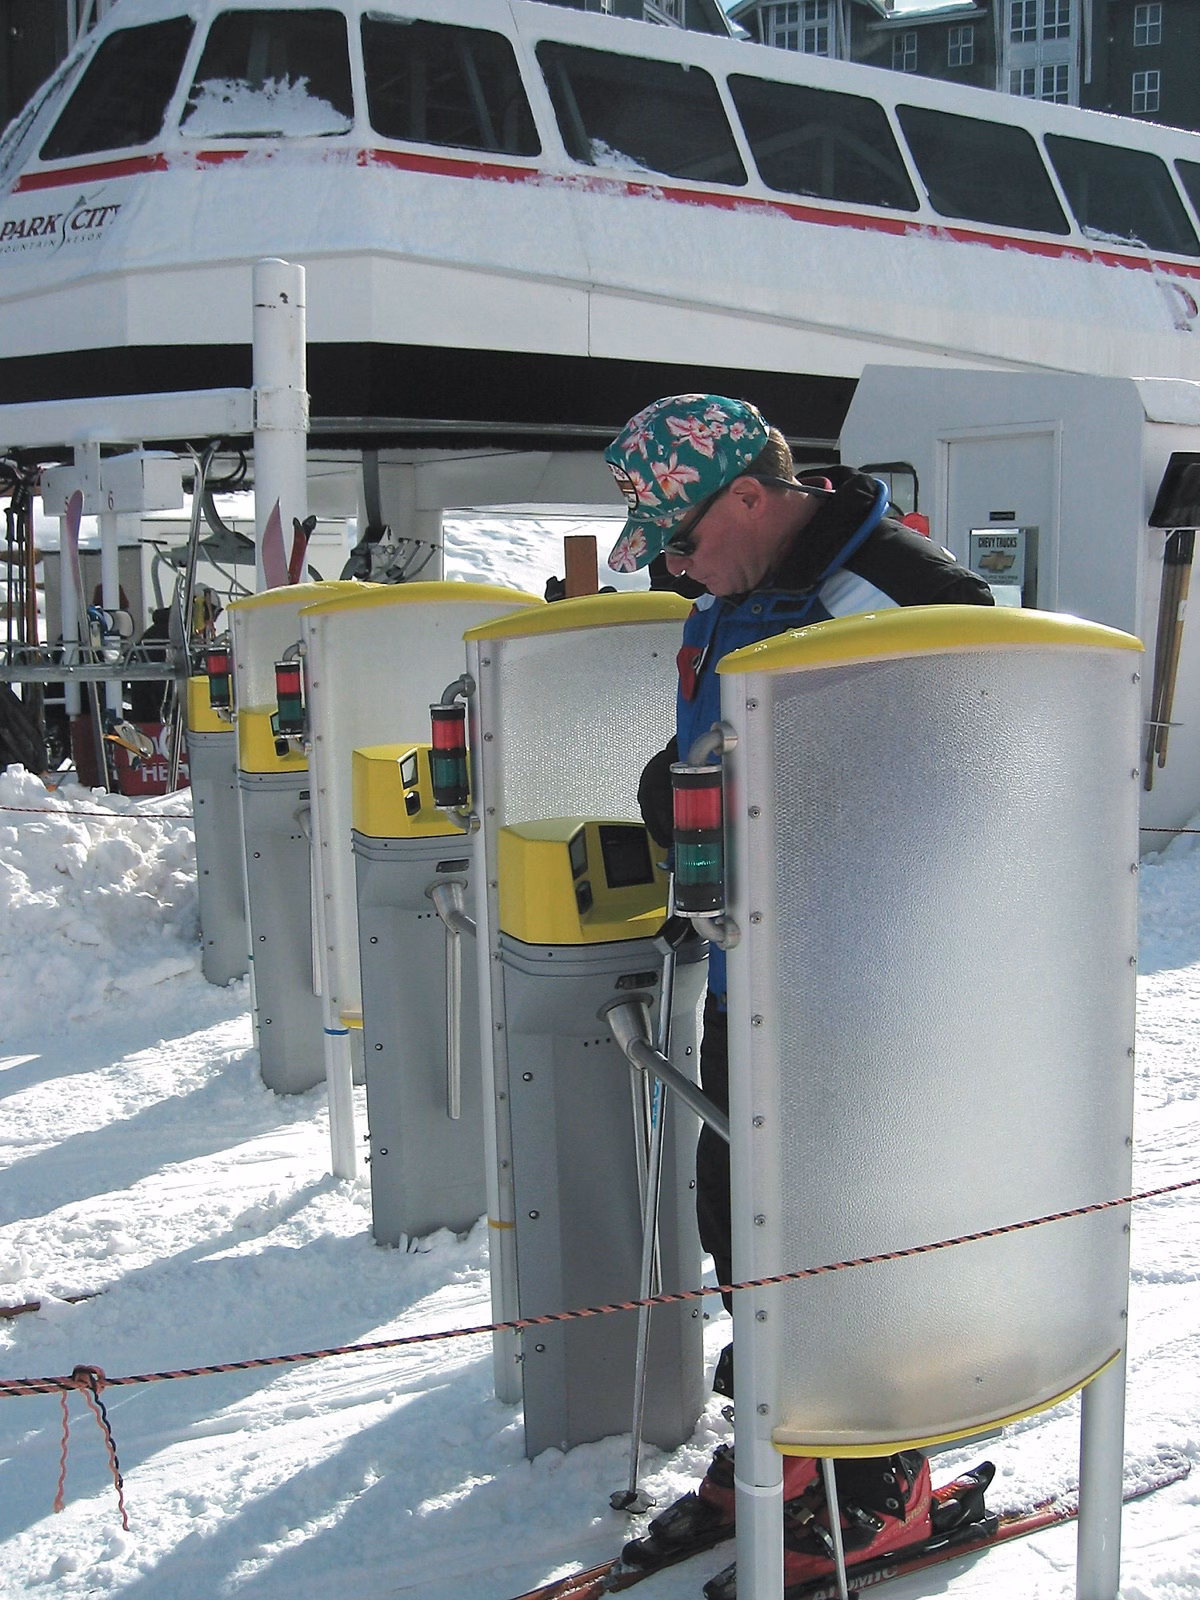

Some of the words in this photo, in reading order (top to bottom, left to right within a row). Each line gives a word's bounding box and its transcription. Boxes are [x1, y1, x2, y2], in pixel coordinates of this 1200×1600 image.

[0, 213, 63, 241] PARK
[107, 490, 114, 511] 6
[978, 537, 995, 548] CHEVY
[996, 537, 1018, 548] TRUCKS
